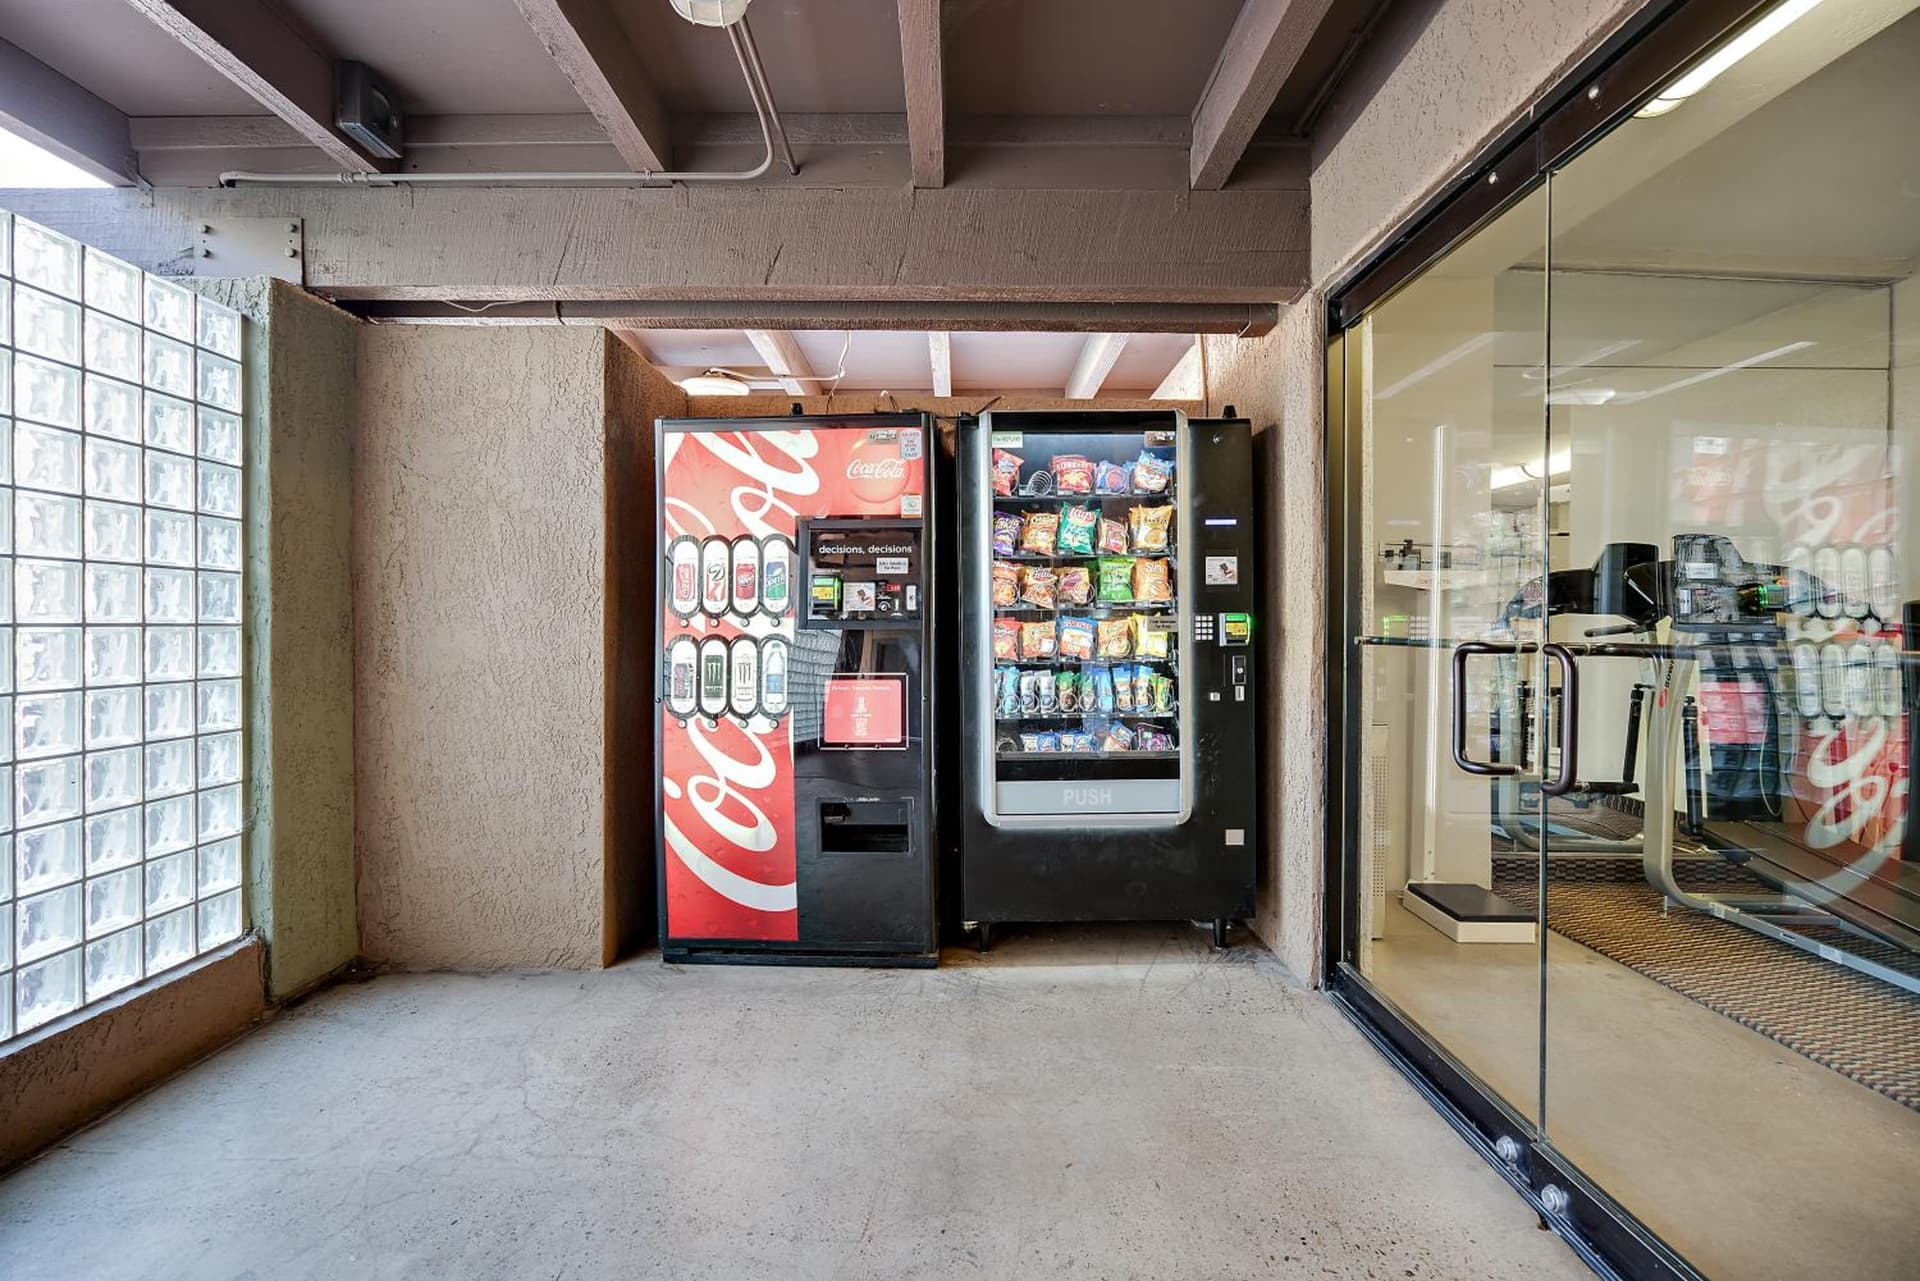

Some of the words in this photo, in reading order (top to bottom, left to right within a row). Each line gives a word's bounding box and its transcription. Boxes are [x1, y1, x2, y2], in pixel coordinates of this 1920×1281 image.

[818, 545, 866, 555] decisions,
[867, 545, 913, 554] decisions
[1064, 788, 1112, 806] PUSH
